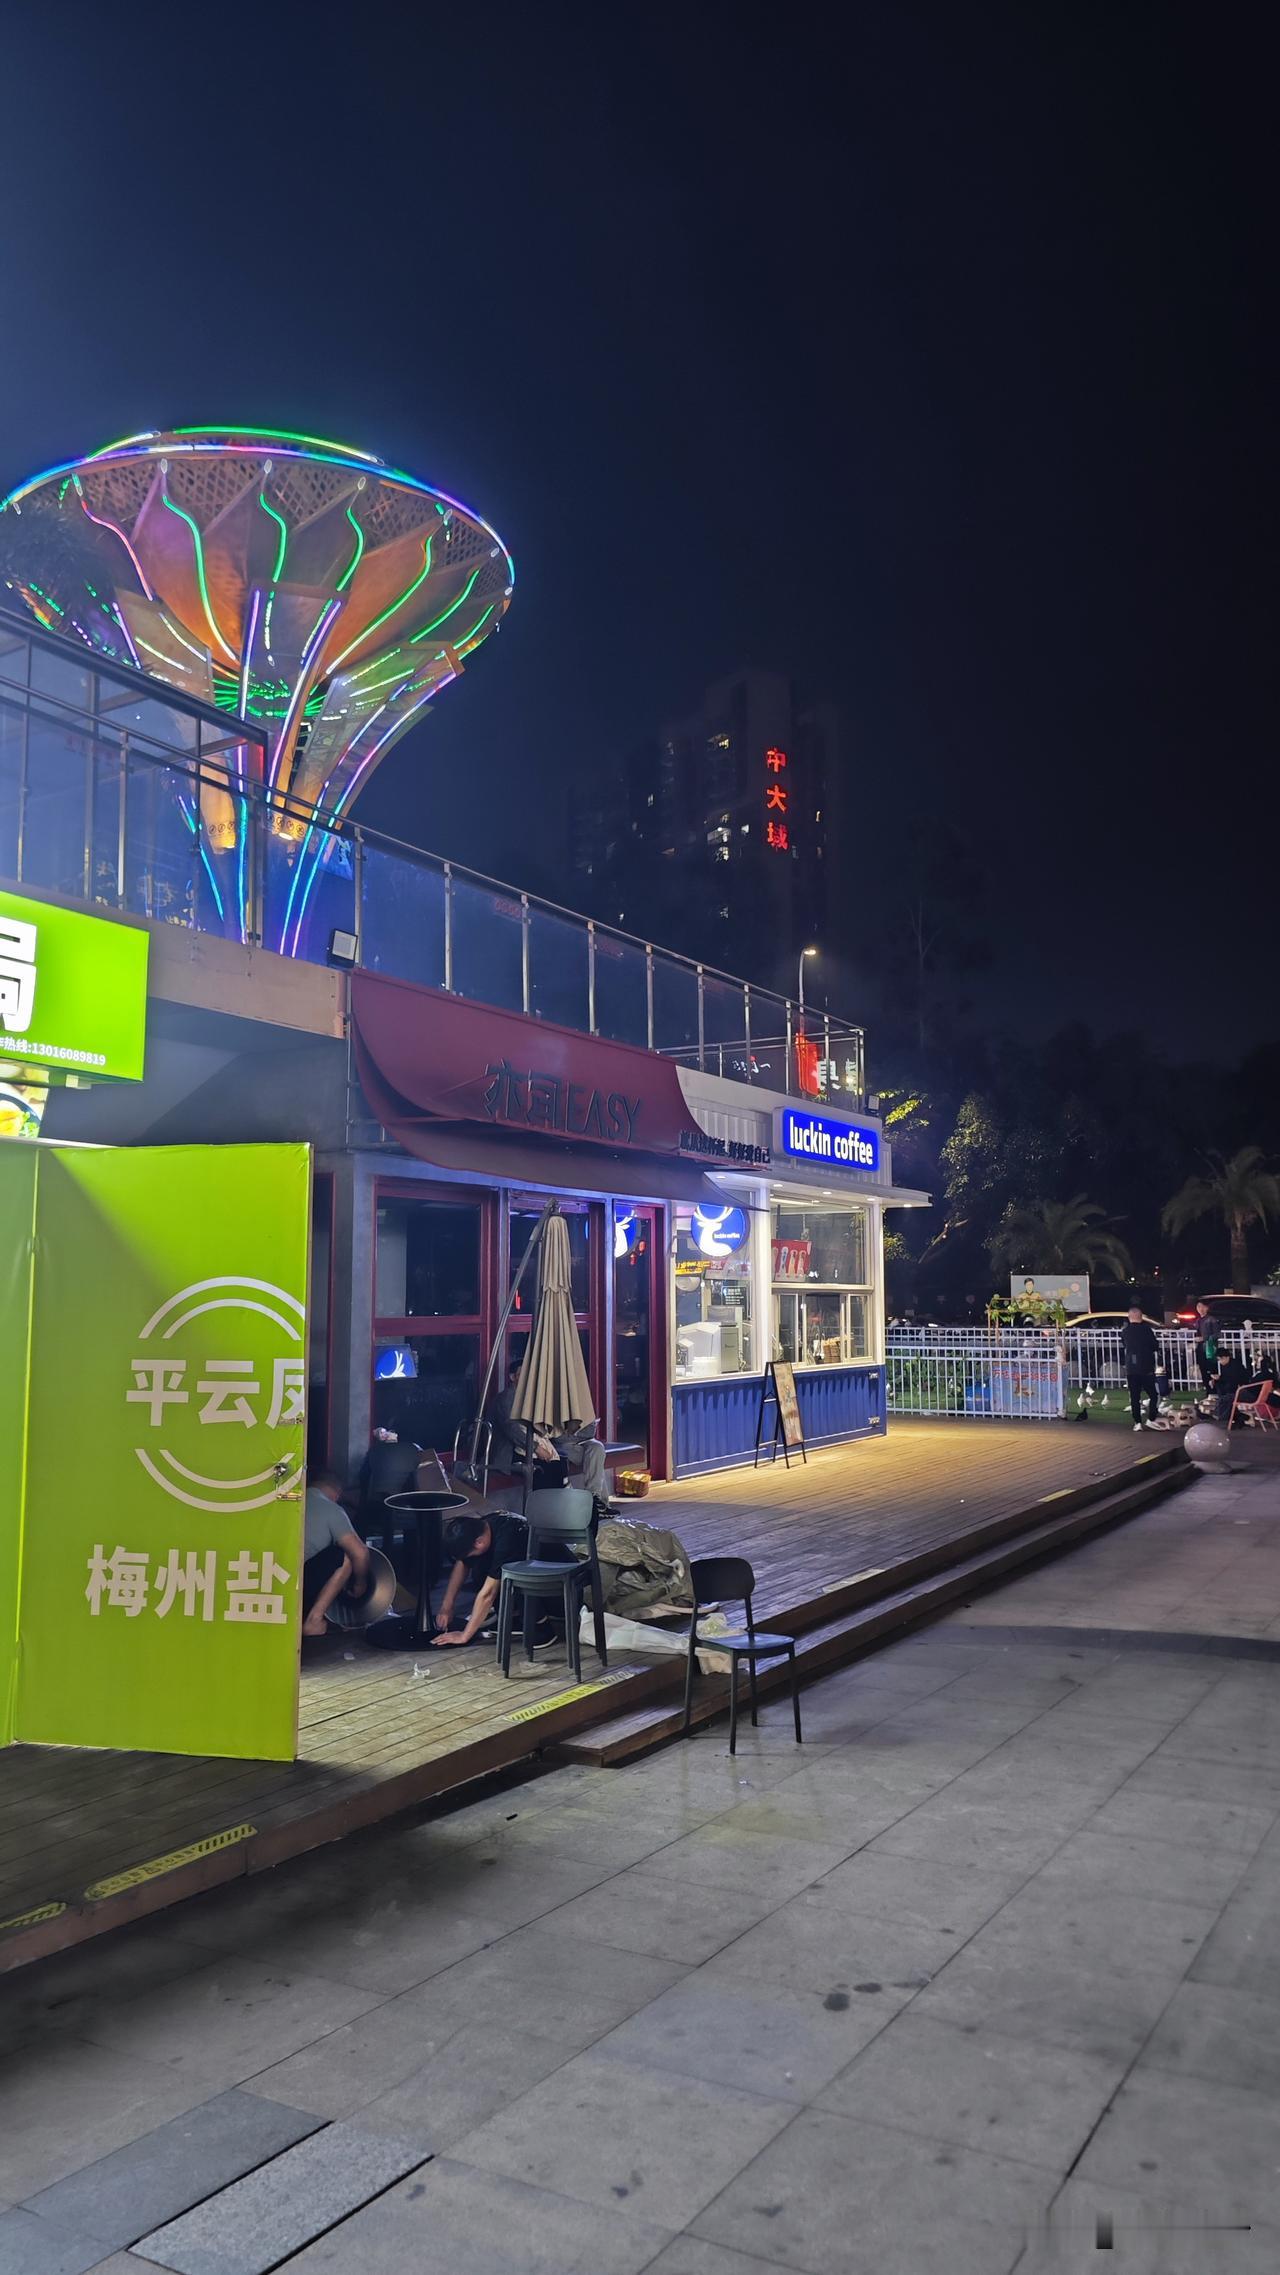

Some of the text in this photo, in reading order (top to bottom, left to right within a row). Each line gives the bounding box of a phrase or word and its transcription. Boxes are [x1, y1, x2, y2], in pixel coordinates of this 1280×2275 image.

[789, 1115, 873, 1165] luckin coffee
[85, 1544, 299, 1624] 梅州盐
